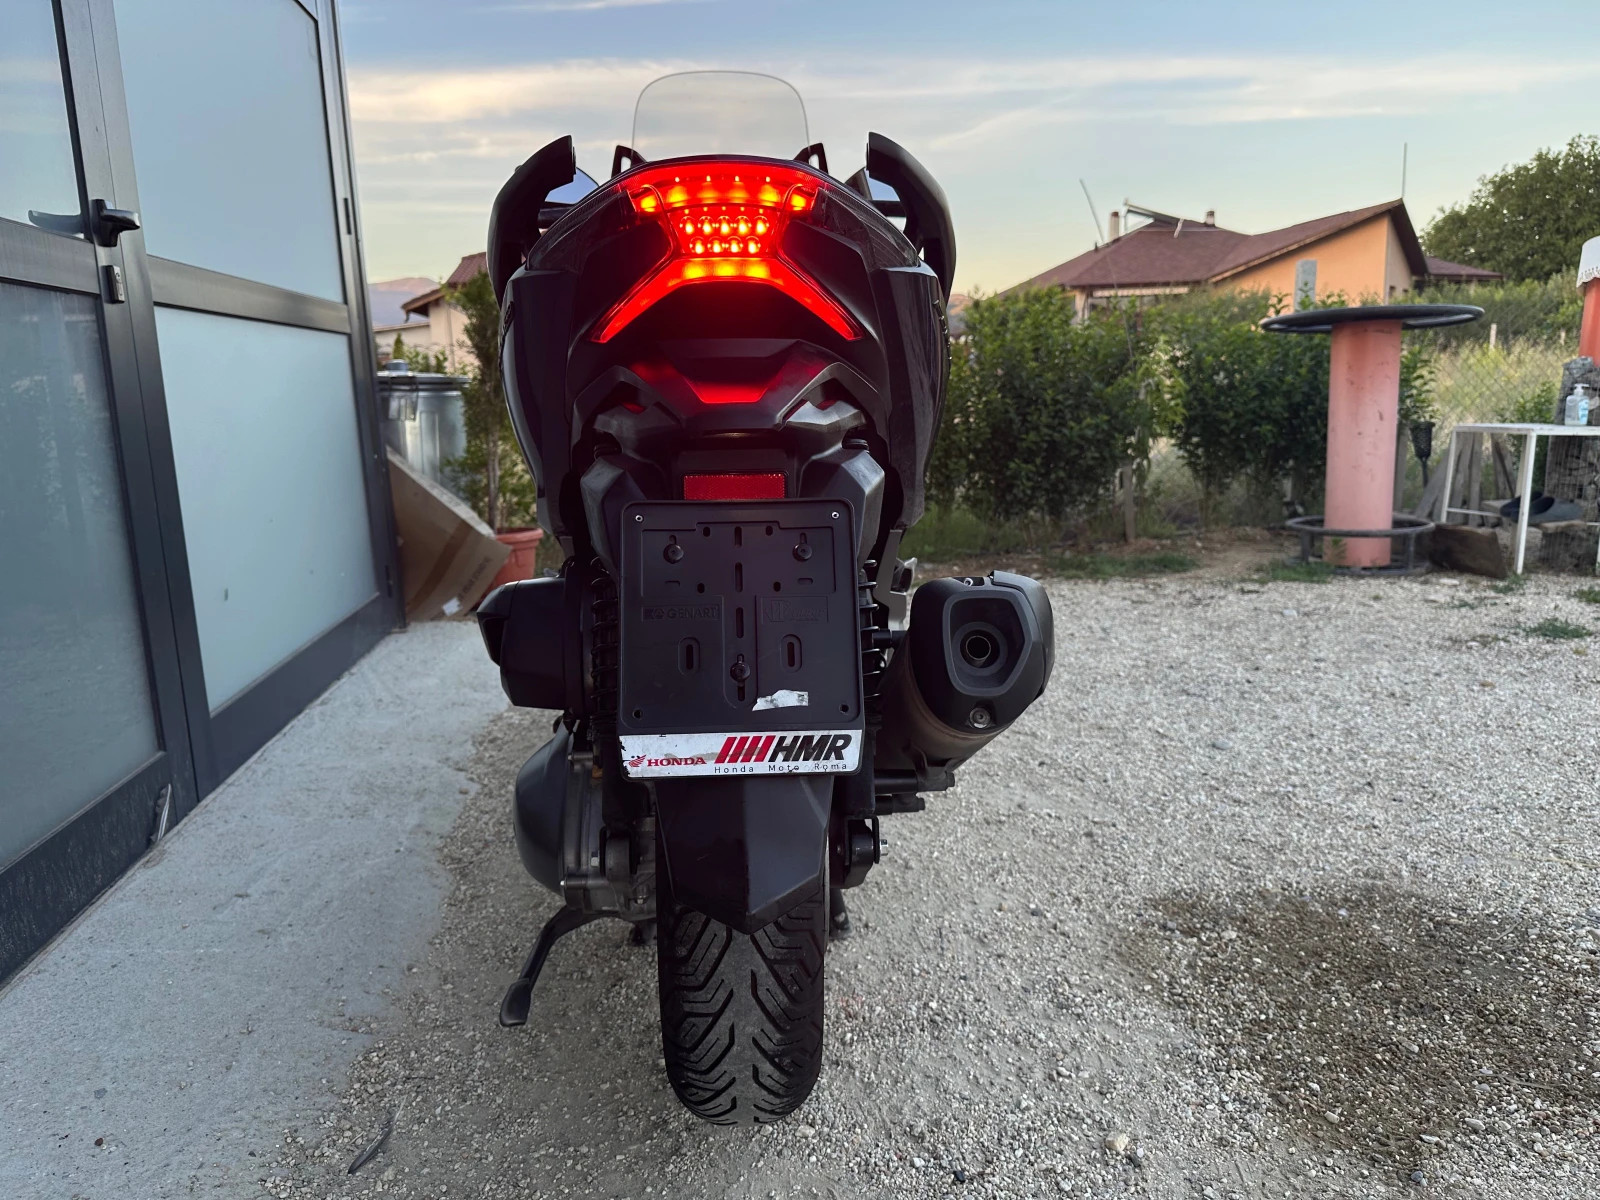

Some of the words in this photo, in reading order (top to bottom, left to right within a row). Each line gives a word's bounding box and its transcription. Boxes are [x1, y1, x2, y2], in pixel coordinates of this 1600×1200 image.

[666, 606, 718, 619] GENART
[768, 734, 852, 762] HMR
[647, 756, 707, 767] HONDA
[714, 765, 755, 774] Honda
[768, 764, 800, 773] Moto
[814, 763, 848, 772] Roma
